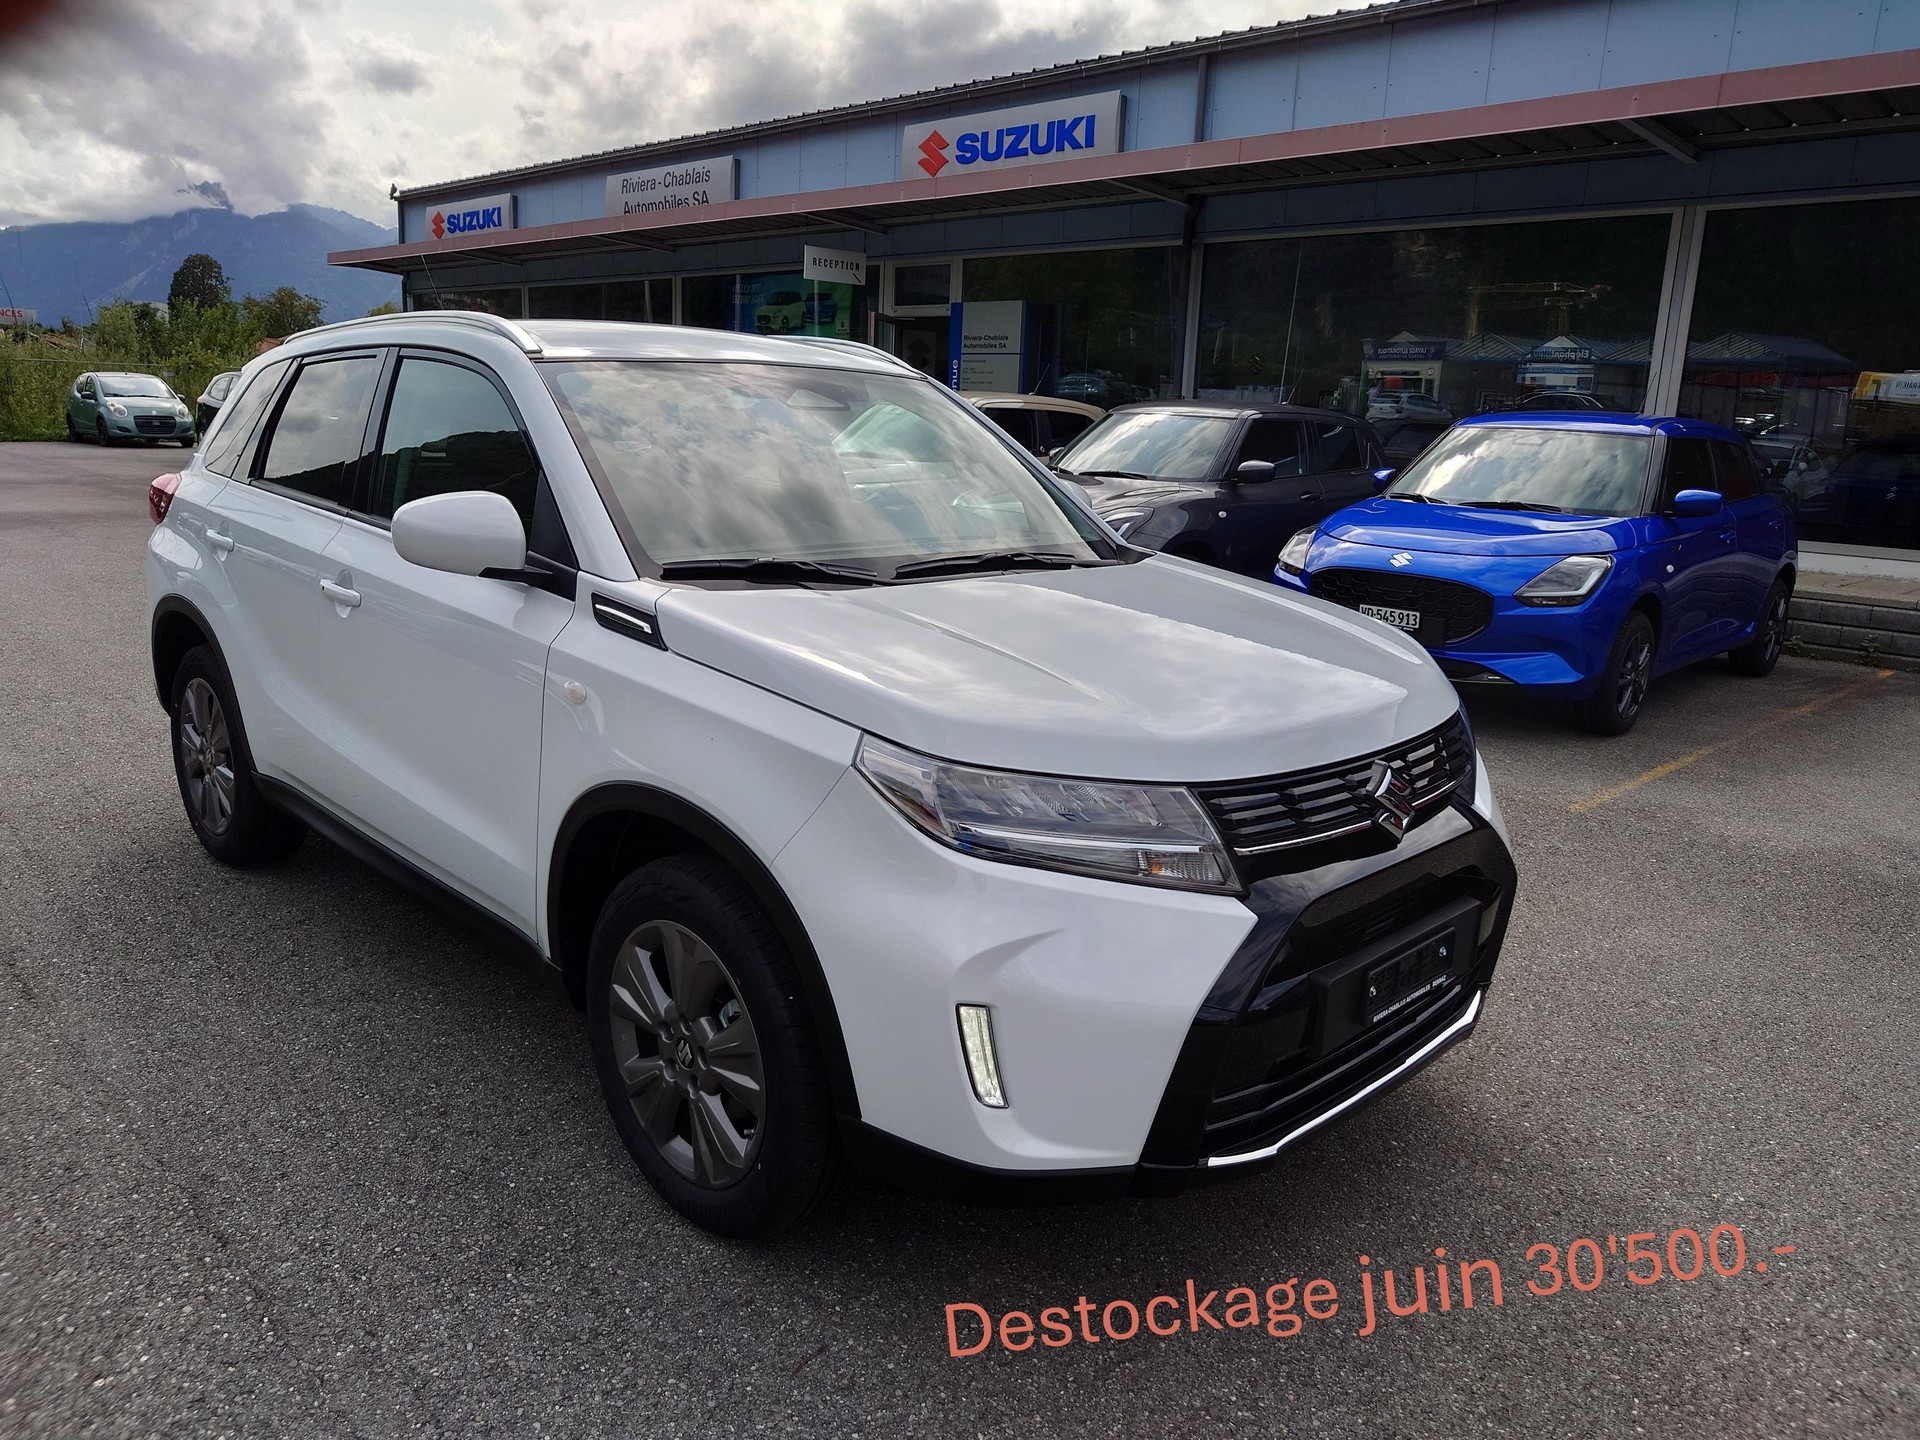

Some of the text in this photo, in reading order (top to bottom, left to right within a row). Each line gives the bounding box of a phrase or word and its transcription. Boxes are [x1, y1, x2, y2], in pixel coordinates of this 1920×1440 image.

[955, 114, 1096, 165] SUZUKI
[692, 190, 710, 206] SA
[447, 206, 502, 234] SUZUKI
[812, 257, 860, 272] RECEPTION
[1397, 612, 1418, 627] 913
